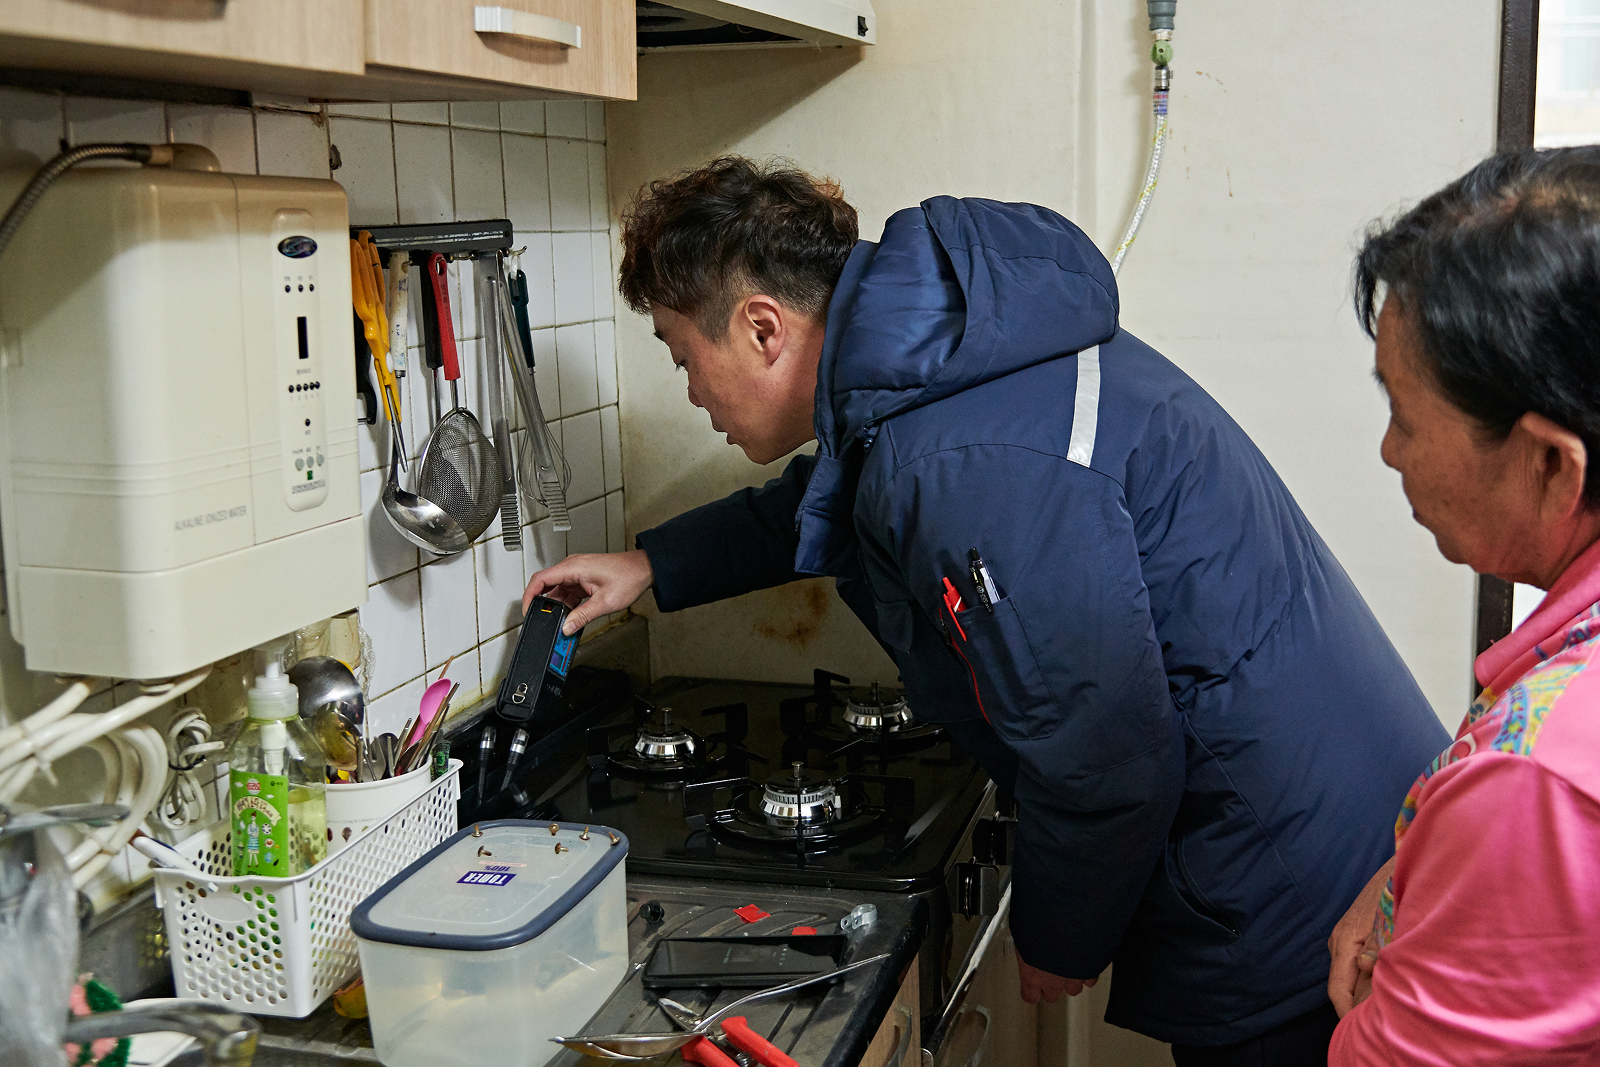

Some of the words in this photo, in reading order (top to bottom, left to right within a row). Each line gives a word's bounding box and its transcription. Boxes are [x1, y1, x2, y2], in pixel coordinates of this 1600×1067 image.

[174, 515, 204, 531] ALKALINE
[205, 509, 227, 524] IONIZED
[229, 505, 247, 518] WATER
[463, 872, 508, 885] TOMER
